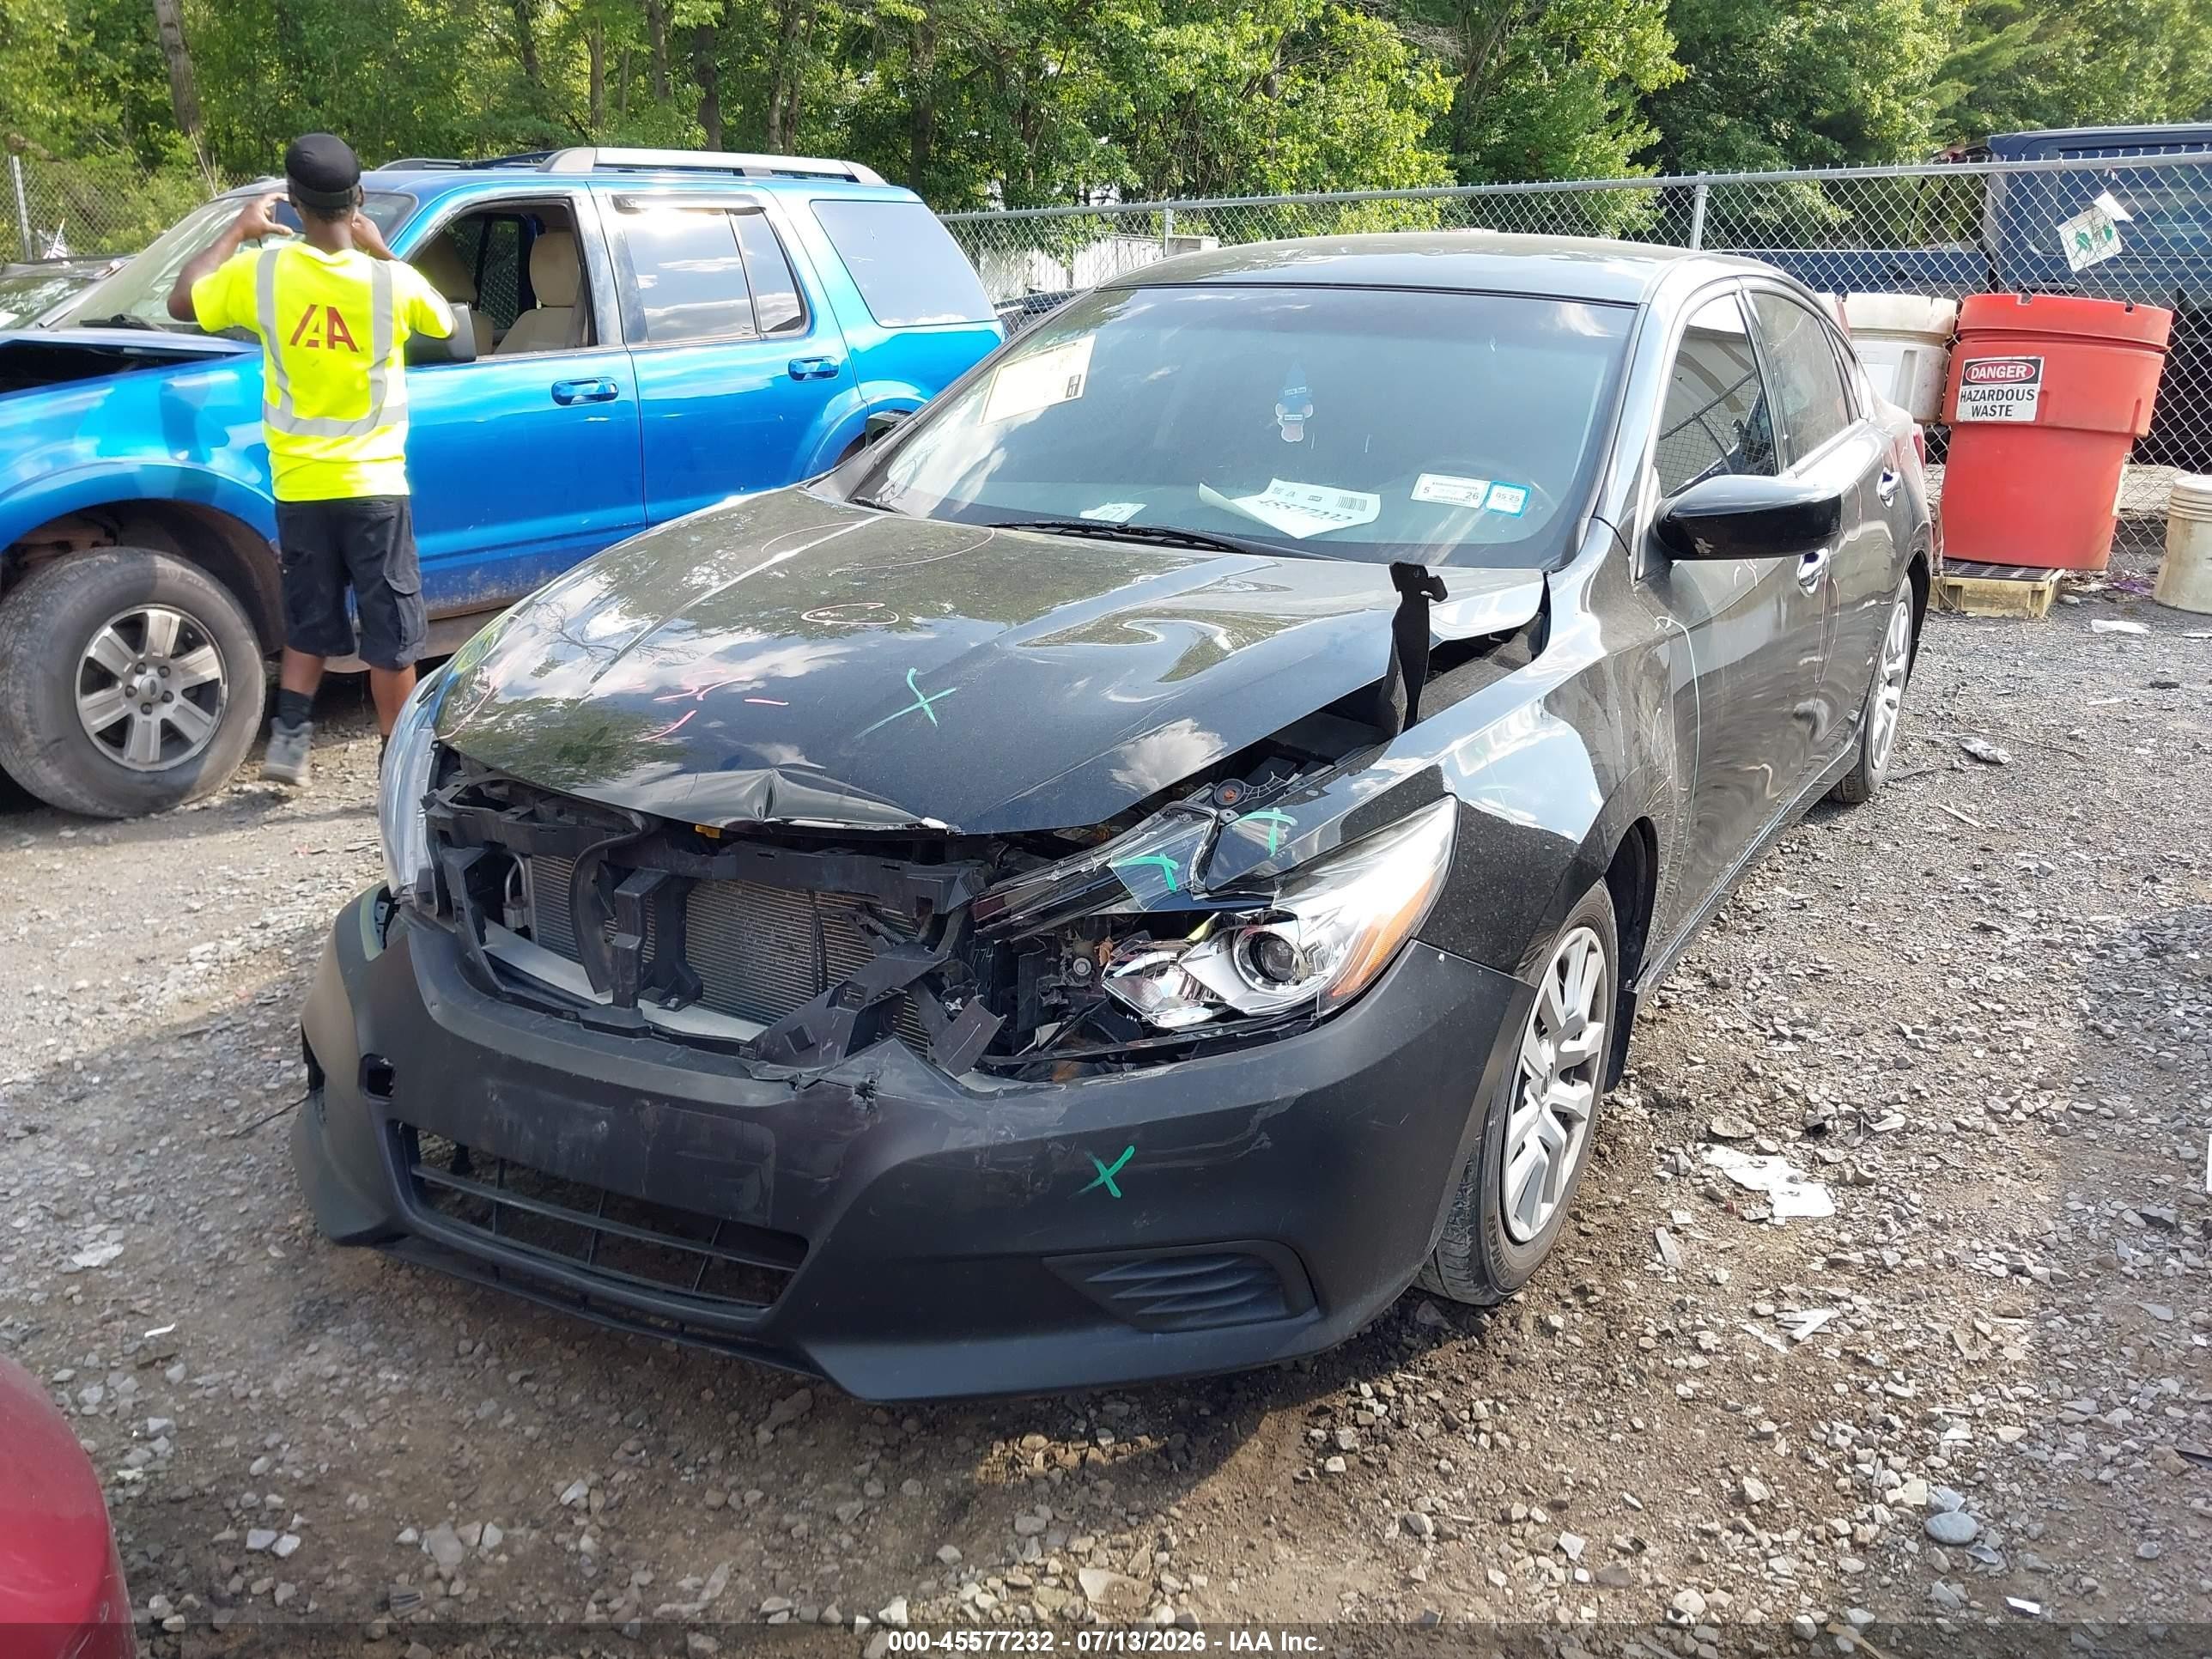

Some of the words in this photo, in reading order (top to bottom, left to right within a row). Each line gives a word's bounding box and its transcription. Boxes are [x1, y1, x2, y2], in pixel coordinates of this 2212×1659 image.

[1971, 365, 2027, 379] DANGER
[1960, 389, 2035, 403] HAZARDOUS
[1972, 404, 2013, 417] WASTE
